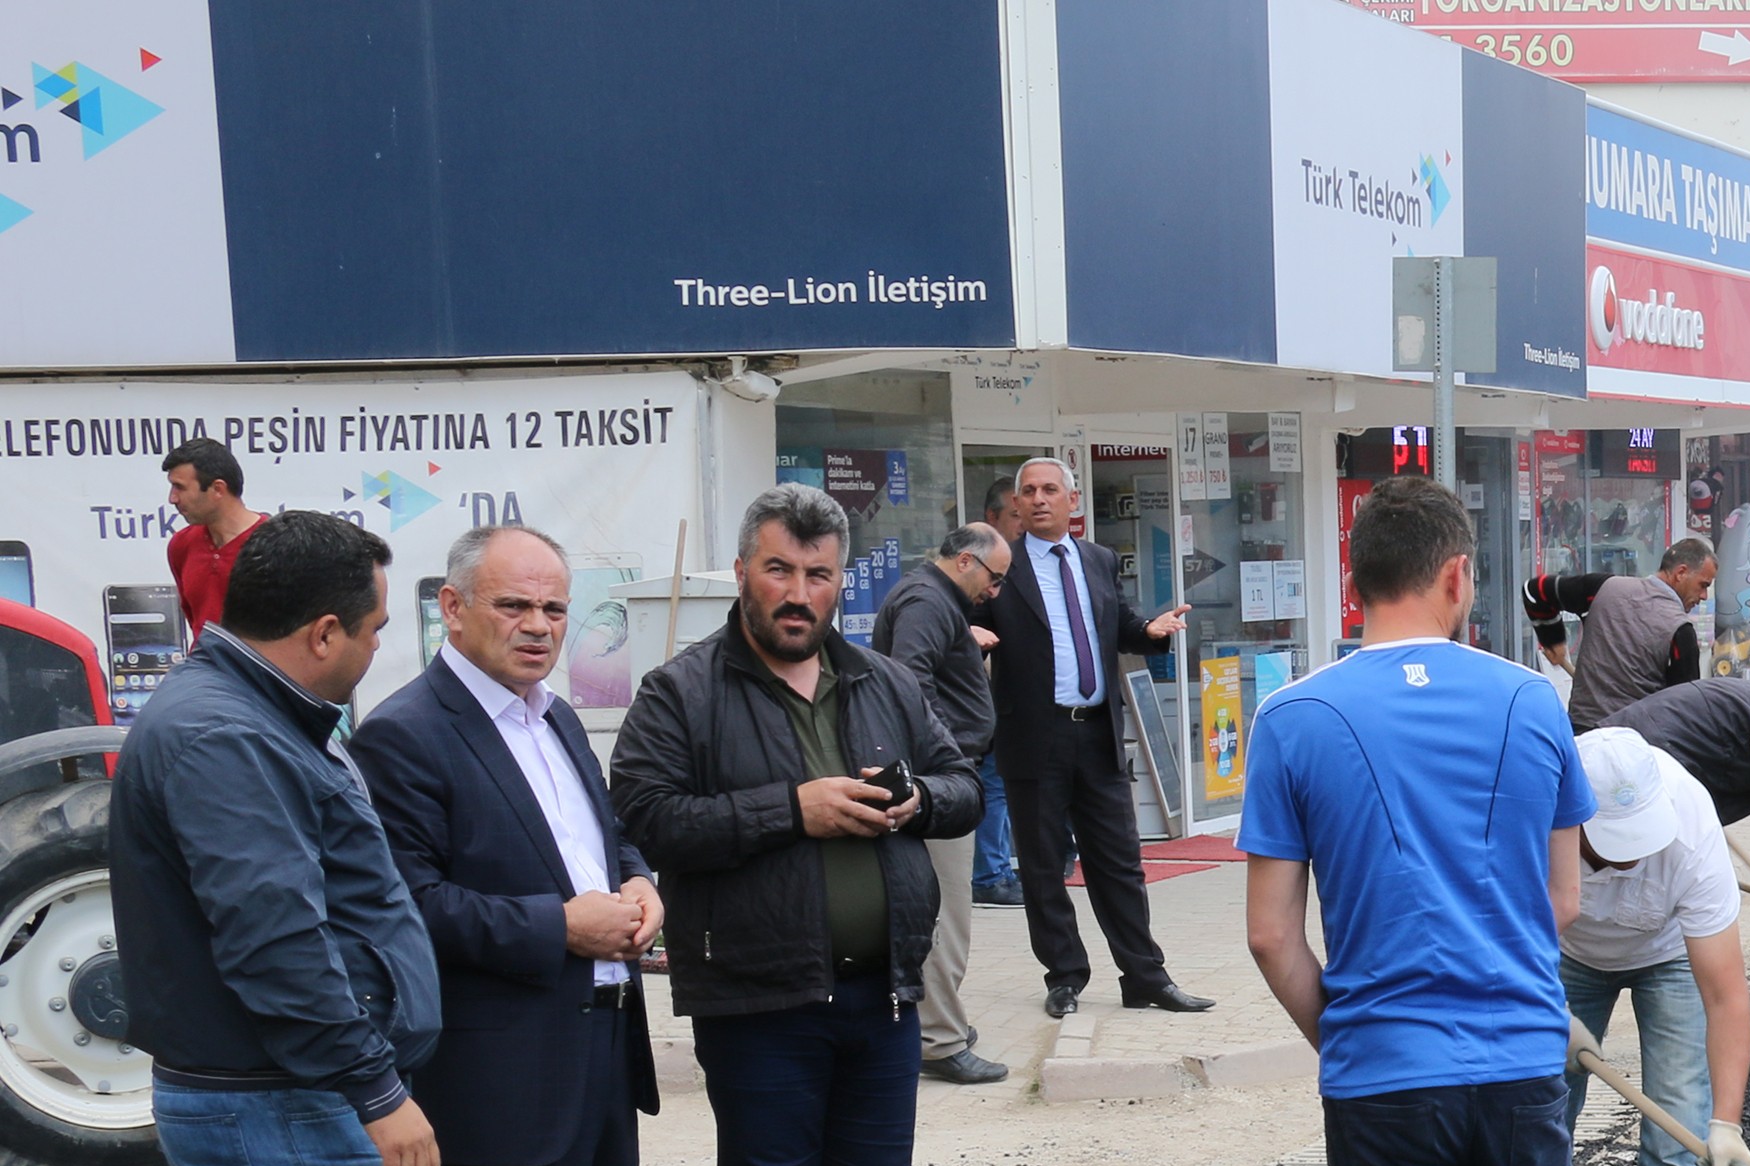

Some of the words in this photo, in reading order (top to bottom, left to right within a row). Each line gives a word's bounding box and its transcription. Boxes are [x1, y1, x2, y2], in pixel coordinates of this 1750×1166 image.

[1586, 134, 1678, 225] UMARA
[1301, 158, 1344, 210] Türk
[1348, 170, 1422, 228] Telekom
[674, 275, 858, 308] Three-Lion
[867, 269, 987, 310] İletişim
[1619, 288, 1705, 350] vodafone
[1523, 342, 1558, 366] Three-Lion
[1557, 347, 1581, 373] İletişim
[975, 375, 991, 390] Türk
[992, 375, 1022, 391] Telekom
[0, 417, 207, 457] LEFONUNDA
[225, 407, 325, 464] PEŞİN
[340, 405, 490, 452] FİYATINA
[505, 412, 543, 447] 12
[555, 398, 674, 447] TAKSİT
[1205, 432, 1227, 445] GRAND
[1629, 428, 1641, 448] 24
[1641, 428, 1655, 448] AY
[1098, 444, 1167, 457] Internet
[827, 454, 853, 466] Prime'la
[853, 469, 862, 478] ve
[893, 461, 898, 475] 3
[859, 480, 876, 491] katla
[90, 504, 180, 540] Türk
[886, 540, 898, 556] 25
[871, 551, 884, 567] 20
[887, 557, 898, 568] GB
[1184, 559, 1203, 572] 57
[858, 562, 869, 577] 15
[873, 568, 884, 579] GB
[859, 578, 870, 590] GB
[844, 589, 855, 601] GB
